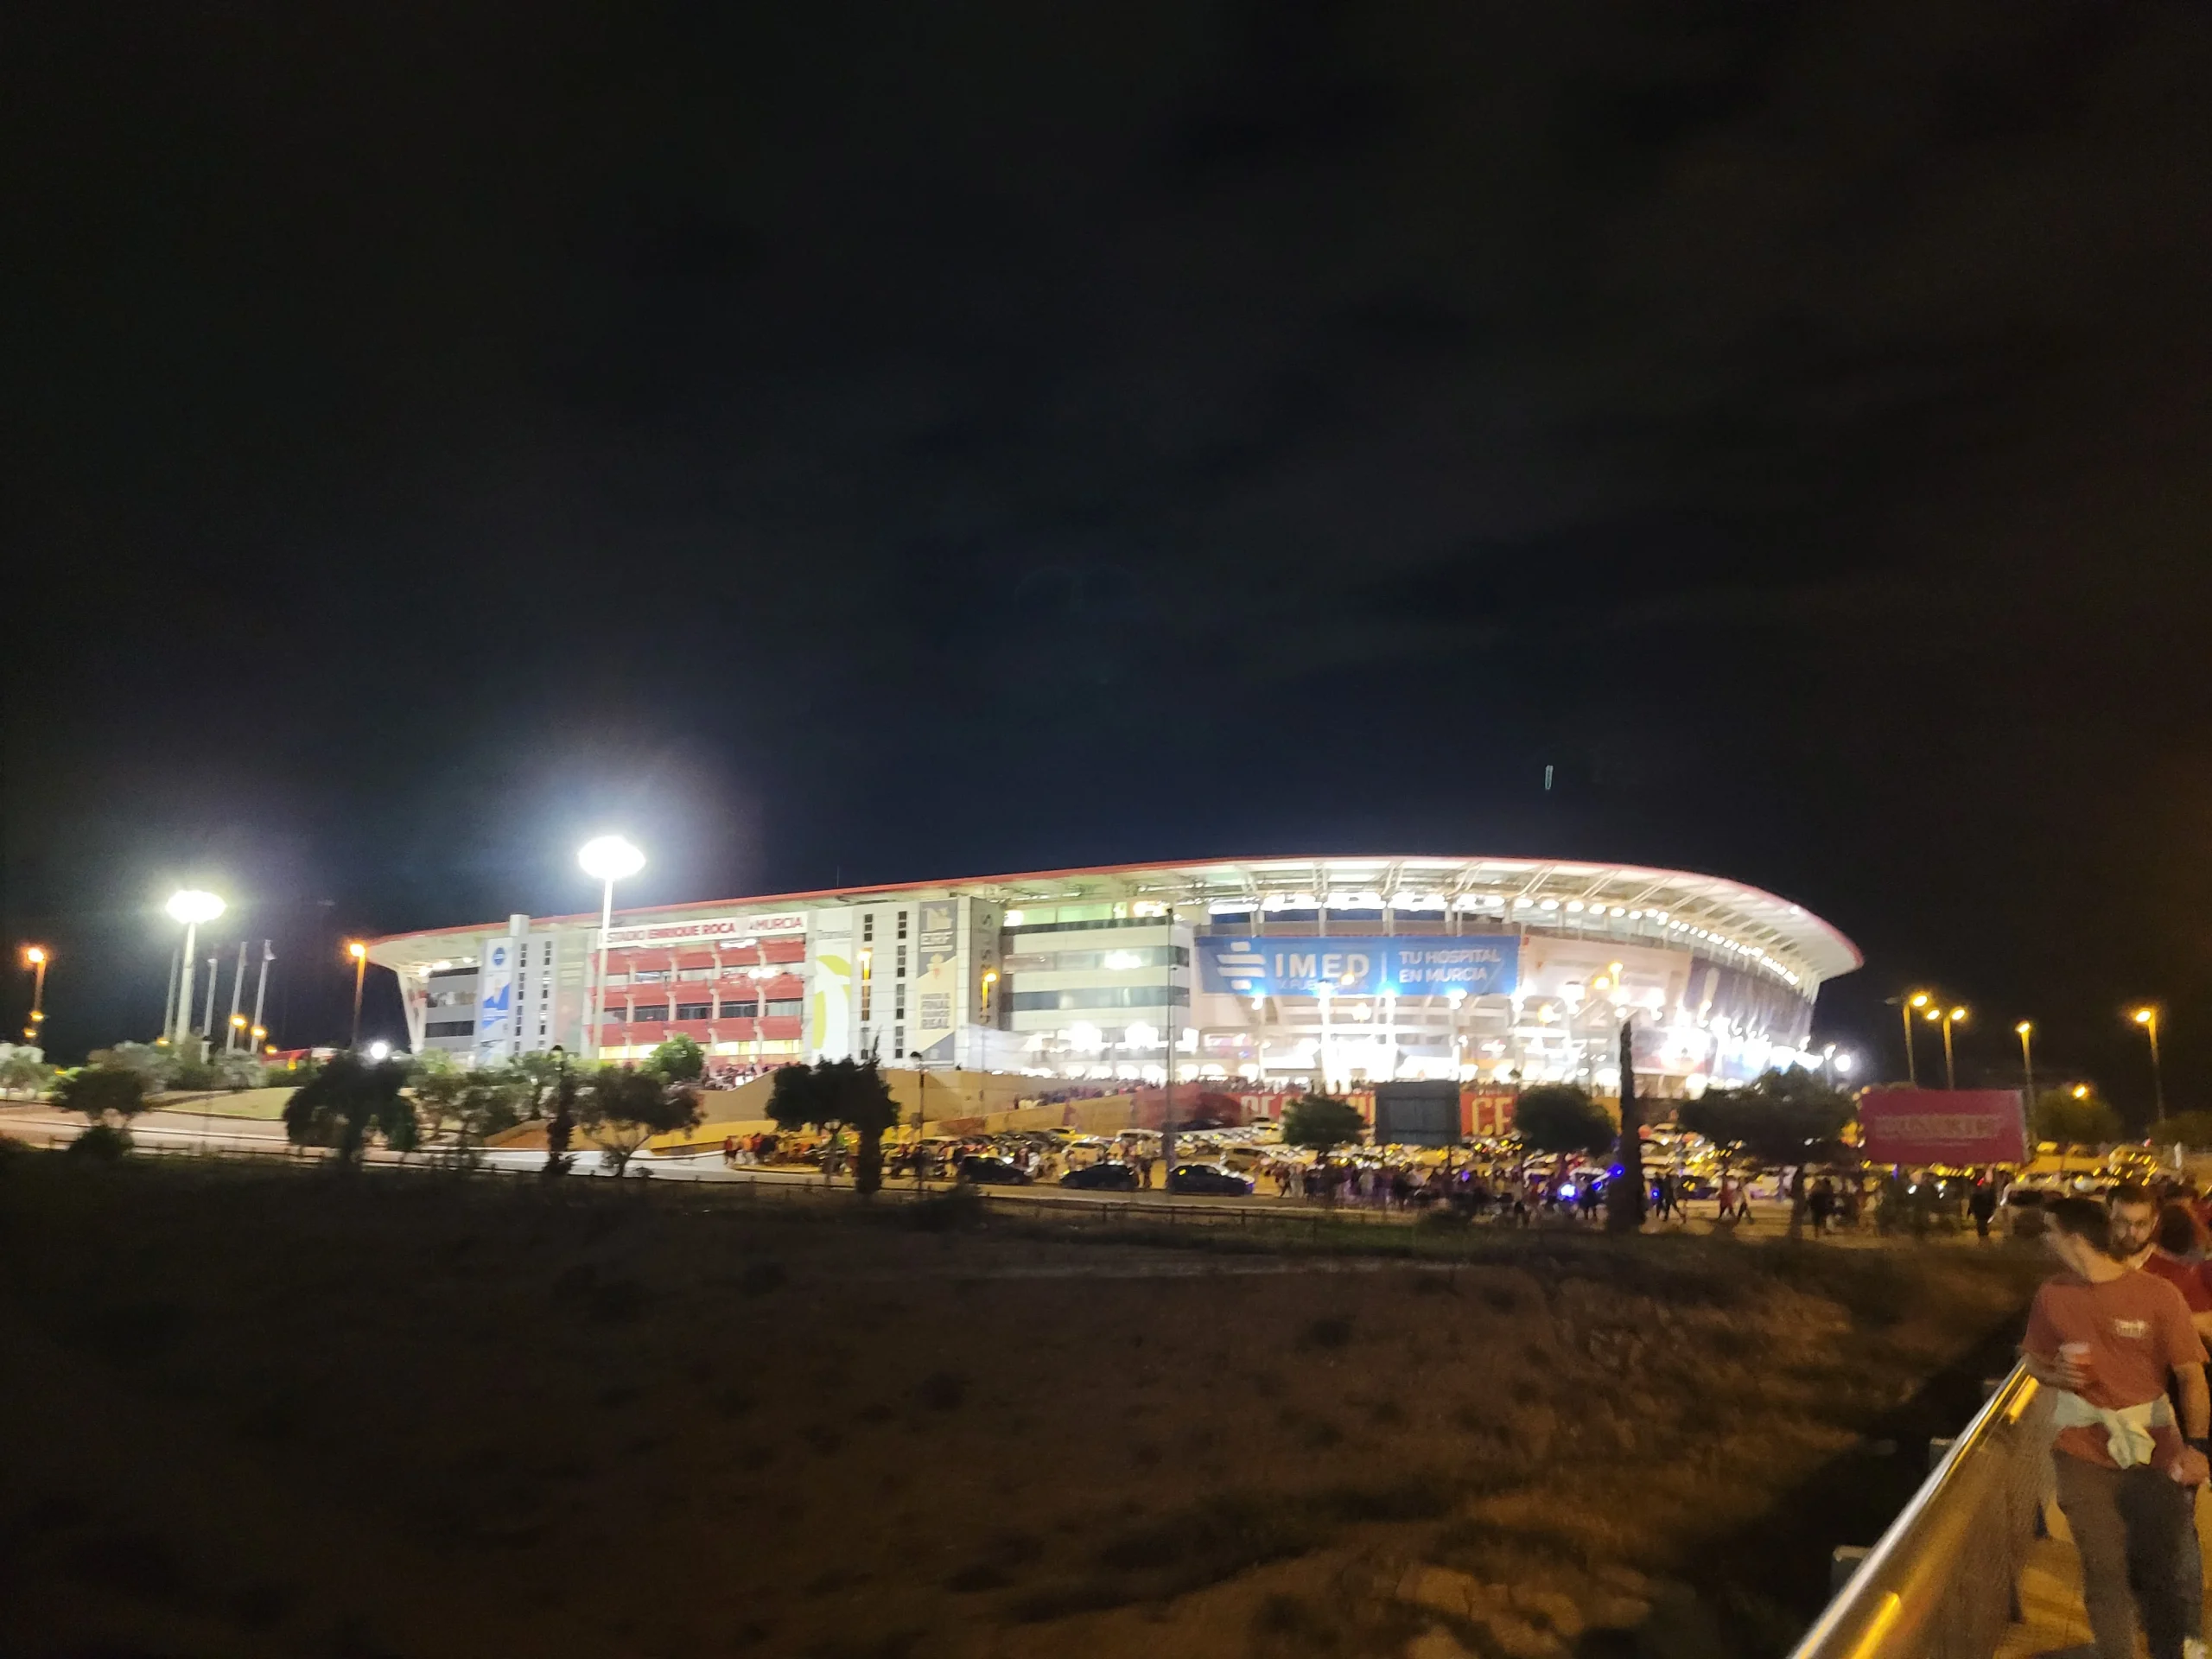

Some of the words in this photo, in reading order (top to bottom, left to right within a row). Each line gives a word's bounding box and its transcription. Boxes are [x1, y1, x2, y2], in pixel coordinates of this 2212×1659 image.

[648, 925, 700, 940] ENRIQUE
[702, 922, 736, 936] ROCA
[753, 917, 803, 931] MURCIA
[1274, 953, 1370, 978] IMED
[1398, 950, 1423, 964] TU
[1425, 948, 1502, 963] HOSPITAL
[1399, 968, 1423, 982] EN
[1426, 966, 1487, 982] MURCIA
